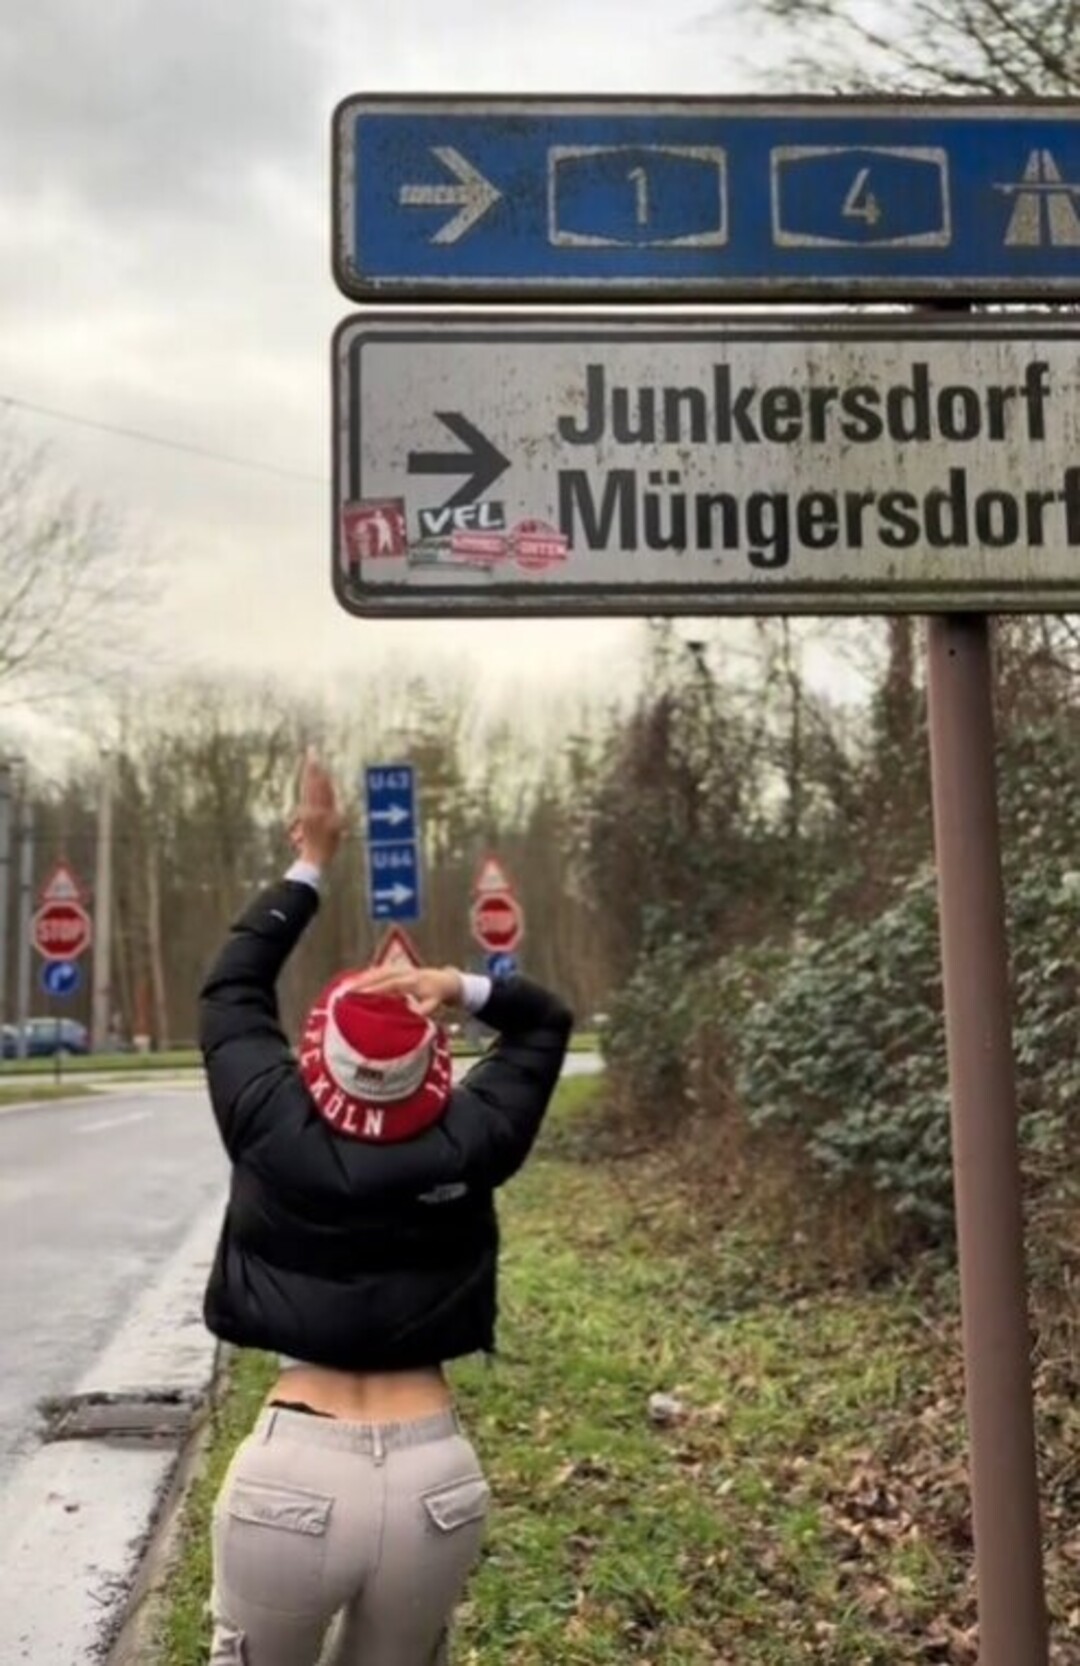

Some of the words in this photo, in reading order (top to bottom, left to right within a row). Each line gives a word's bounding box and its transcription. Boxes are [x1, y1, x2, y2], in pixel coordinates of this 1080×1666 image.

[627, 165, 648, 226] 1
[841, 167, 882, 228] 4
[558, 361, 1050, 446] Junkersdorf
[558, 467, 1080, 569] Müngersdorf
[37, 917, 84, 943] STOP
[308, 1075, 385, 1138] KÖLN
